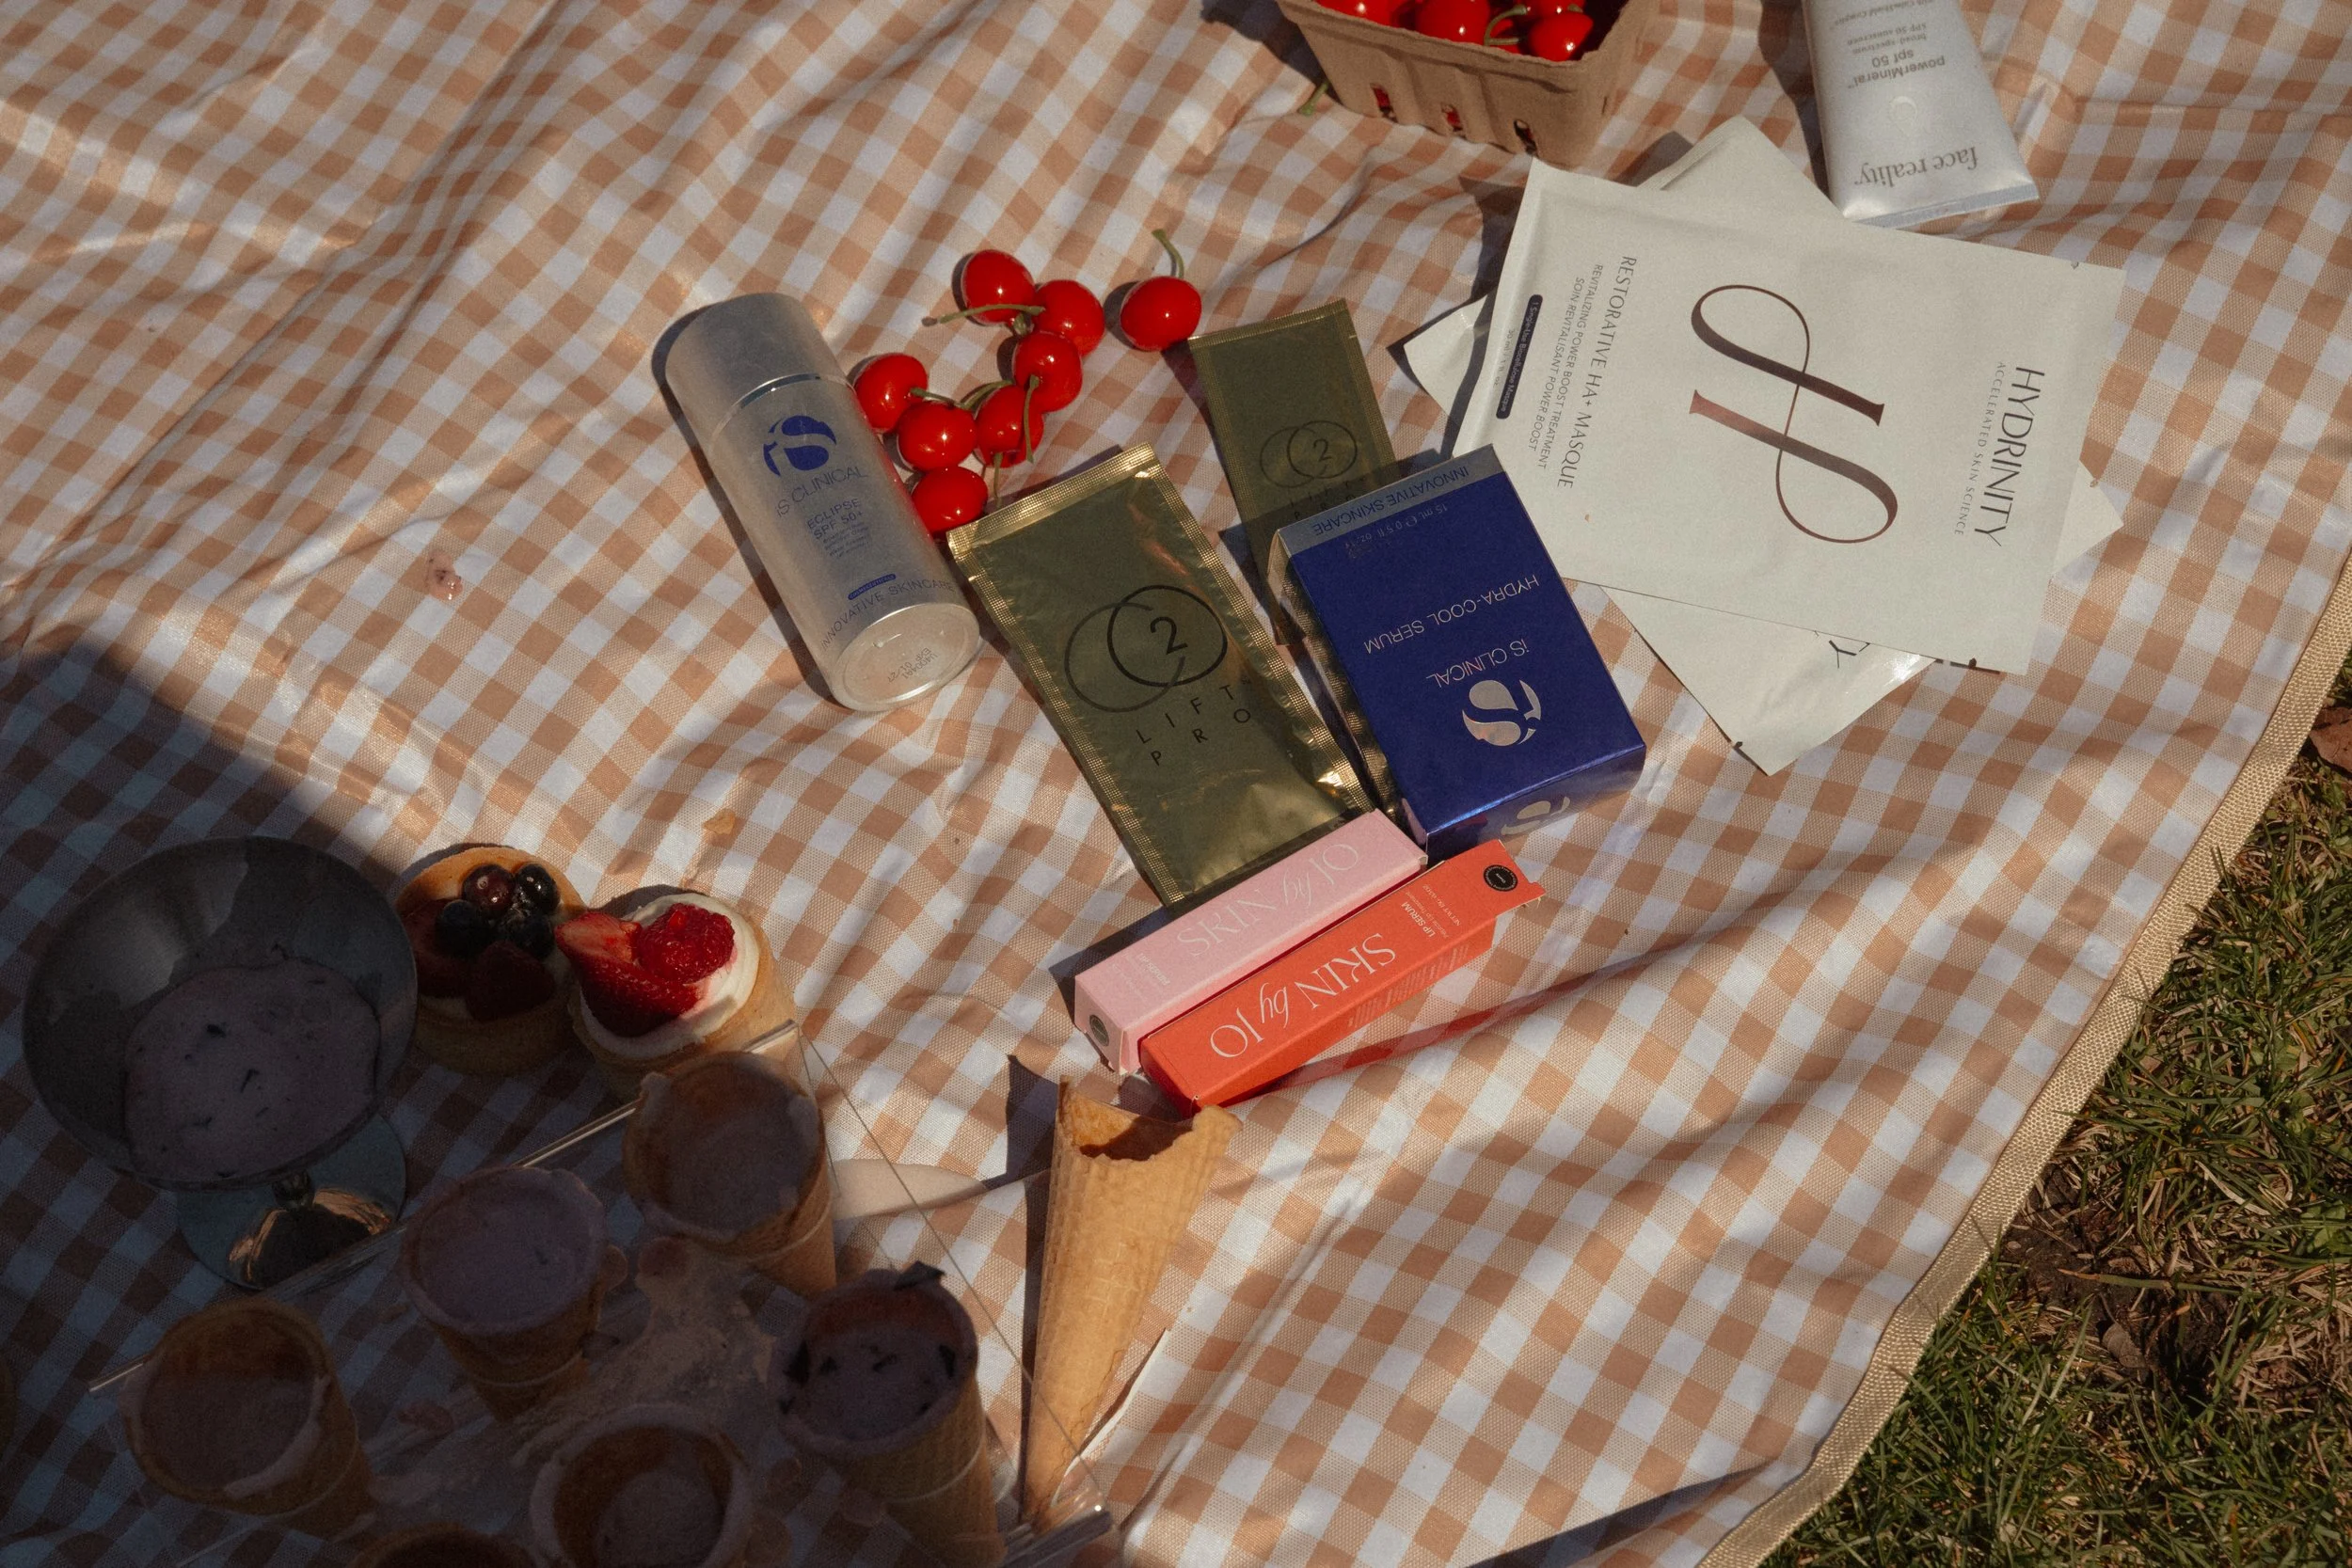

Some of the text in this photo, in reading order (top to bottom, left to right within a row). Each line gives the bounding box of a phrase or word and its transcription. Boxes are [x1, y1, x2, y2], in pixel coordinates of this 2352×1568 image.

[1869, 48, 1915, 68] spf 50
[1858, 145, 1979, 188] face reality
[1526, 276, 1585, 451] SOIN REVITALISANT POWER BOOST
[1534, 262, 1604, 469] REVITALIZING POWER BOOST TREATMENT
[1555, 255, 1637, 489] RESTORATIVE HA+ MASQUE
[1498, 383, 1514, 413] Masque
[1953, 360, 2006, 536] ACCELERATED SKIN SCIENCE
[1973, 366, 2044, 547] HYDRINITY
[790, 464, 868, 503] CLINICAL
[805, 497, 862, 530] ECLIPSE
[1311, 465, 1469, 536] INNOVATIVE SKINCARE
[812, 518, 838, 539] SPF
[839, 508, 865, 525] 50+
[818, 590, 885, 651] INNOVATIVE
[1361, 574, 1540, 654] HYDRA-COOL SERUM
[1424, 644, 1508, 688] CLINICAL
[1135, 683, 1234, 744] LIFT
[1149, 706, 1251, 767] PRO
[1176, 887, 1278, 957] SKIN
[1308, 845, 1360, 885] JO
[1400, 900, 1436, 938] LIP SERUM
[1293, 931, 1397, 1010] SKIN
[1208, 1006, 1264, 1058] JO
[1261, 982, 1288, 1027] by
